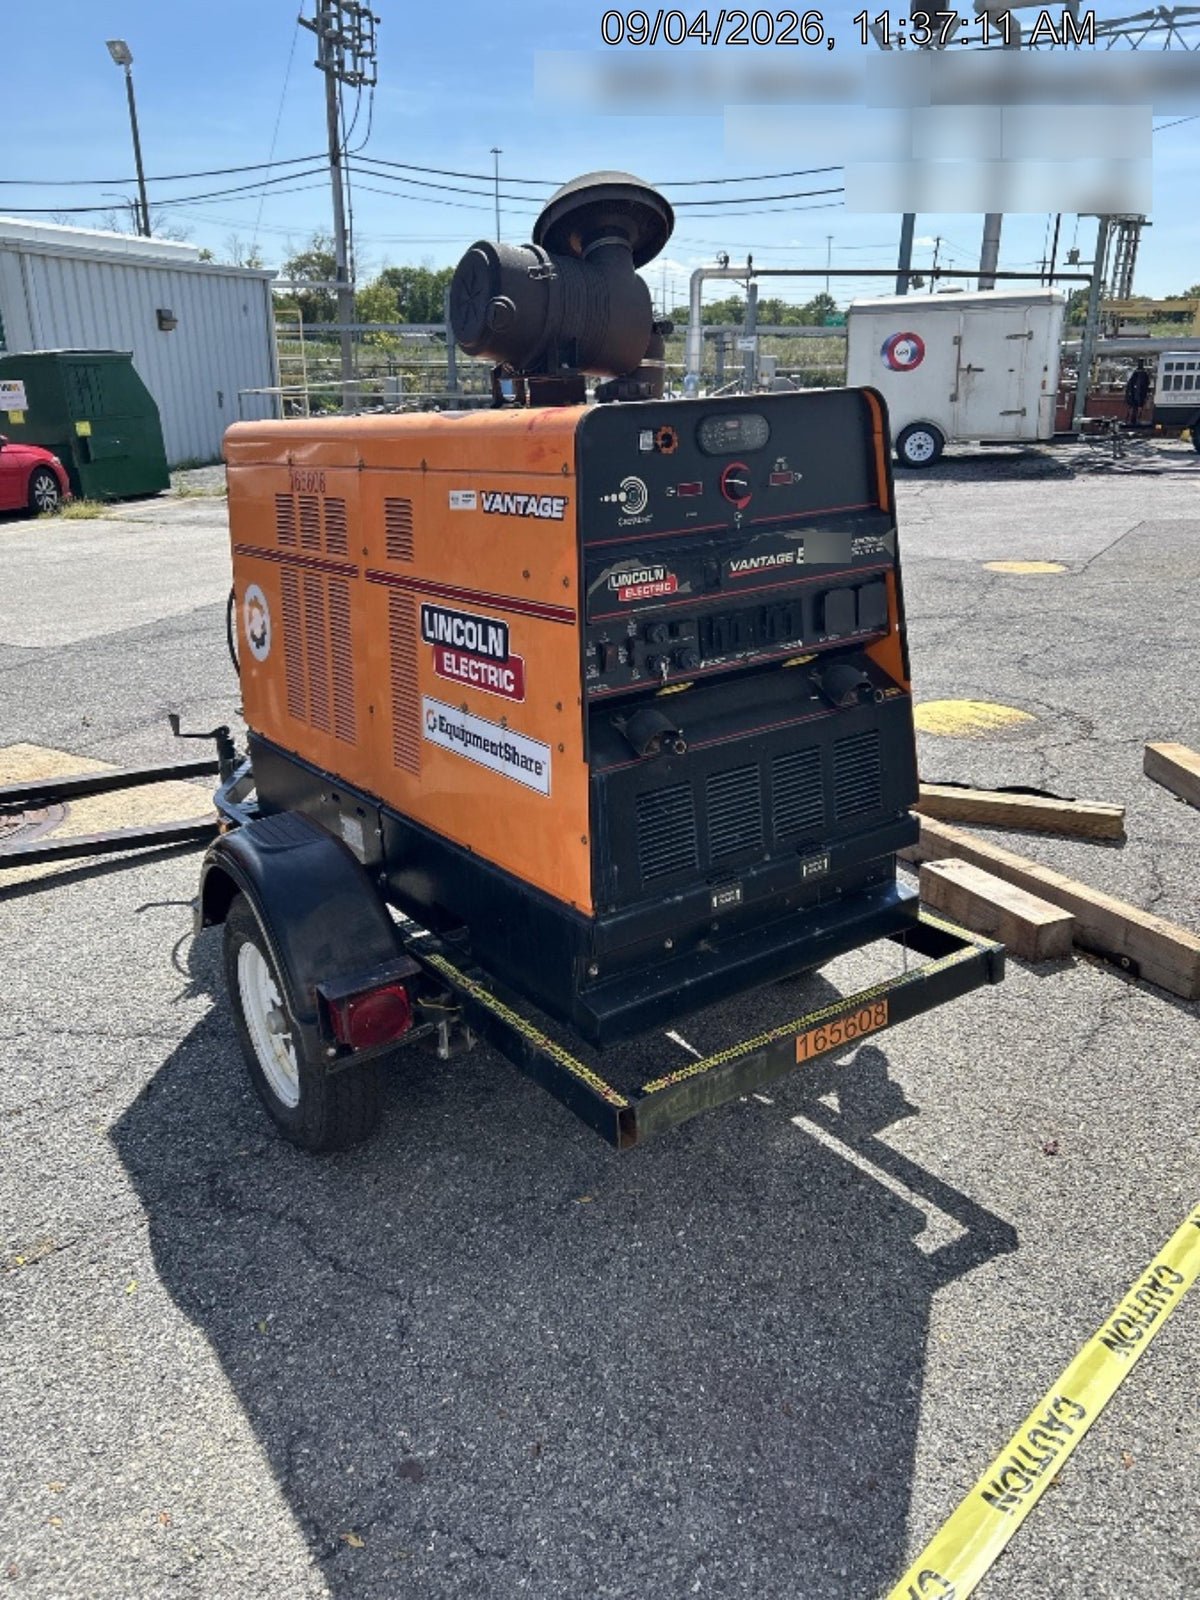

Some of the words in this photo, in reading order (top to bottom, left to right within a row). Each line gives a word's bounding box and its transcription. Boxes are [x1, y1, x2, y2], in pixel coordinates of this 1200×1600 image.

[481, 492, 566, 520] VANTAGE
[611, 568, 665, 587] LINCOLN
[730, 552, 795, 571] VANTAGE
[625, 582, 671, 598] ELECTRIC
[424, 611, 505, 658] LINCOLN
[443, 652, 515, 692] ELECTRIC
[438, 714, 543, 776] EquipmentShare
[800, 1003, 886, 1056] 165608
[1099, 1265, 1184, 1357] CAUTION
[981, 1396, 1086, 1515] CAUTION
